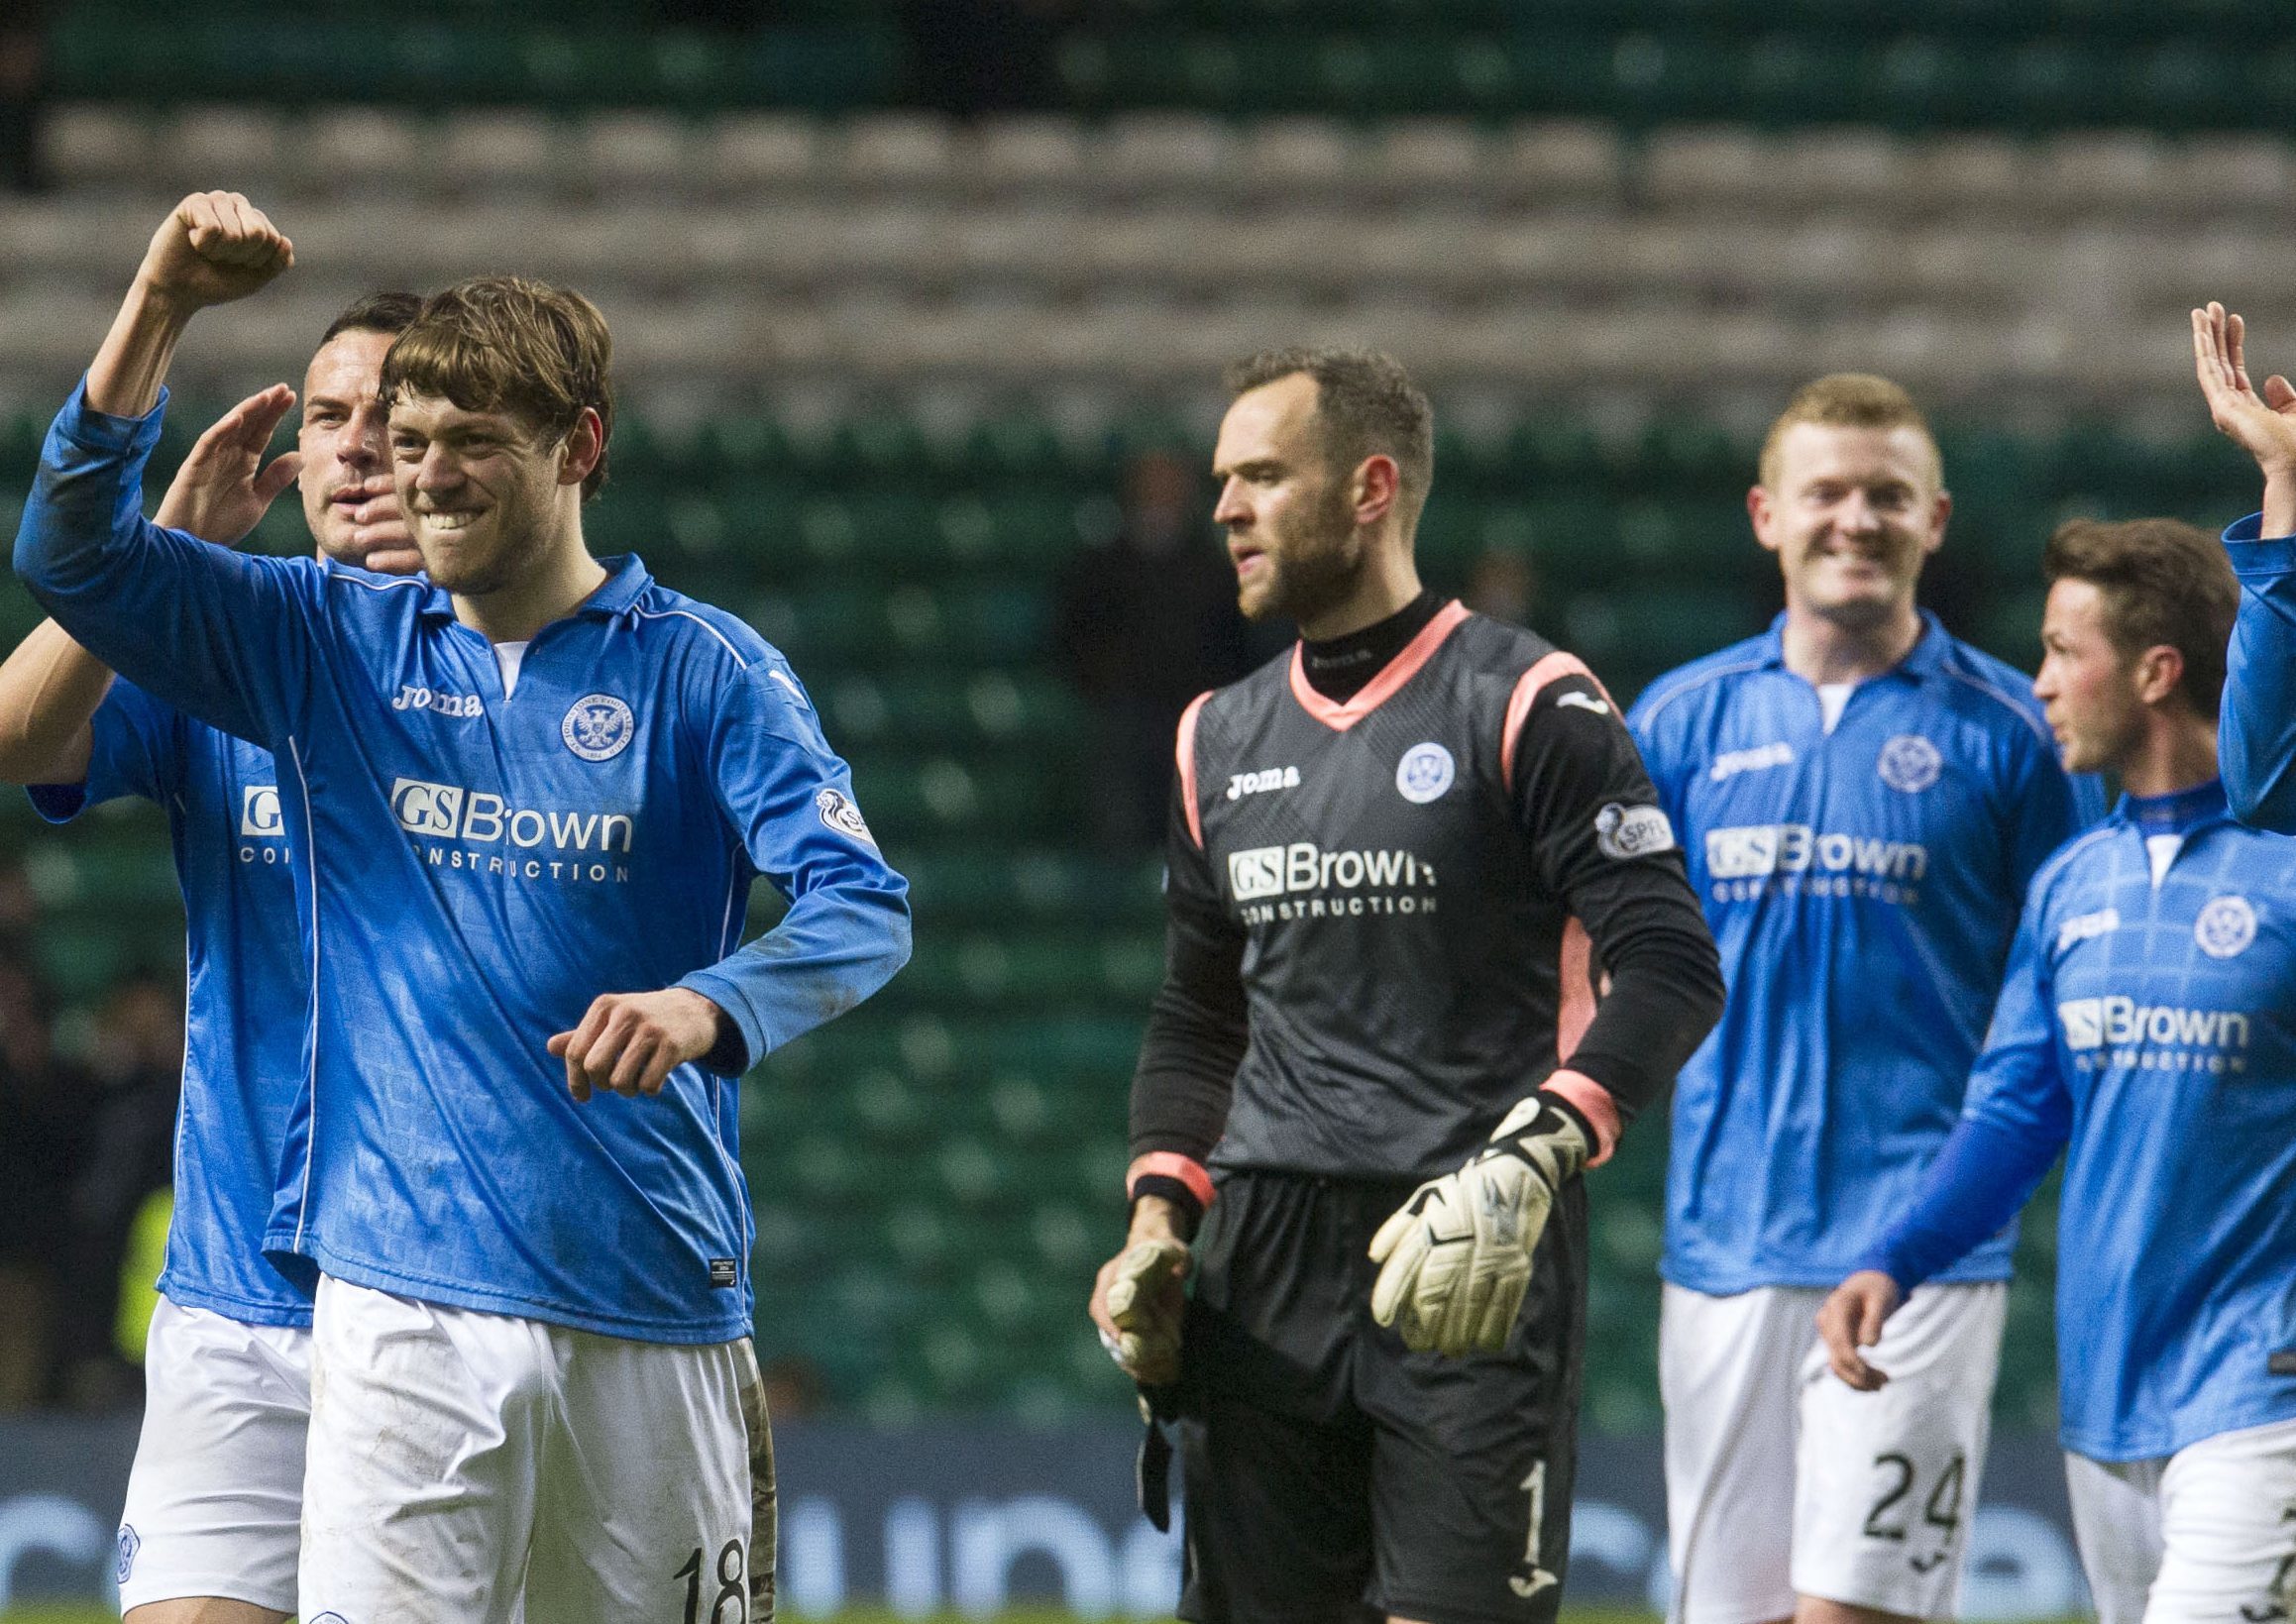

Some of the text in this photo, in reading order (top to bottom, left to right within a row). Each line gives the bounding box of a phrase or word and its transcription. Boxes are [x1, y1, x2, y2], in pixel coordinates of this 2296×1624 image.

[392, 685, 484, 717] Joma
[393, 783, 456, 832] GS
[1227, 766, 1301, 801] Joma
[2102, 995, 2249, 1048] Brown
[1862, 1450, 1966, 1547] 24
[673, 1538, 747, 1624] 18
